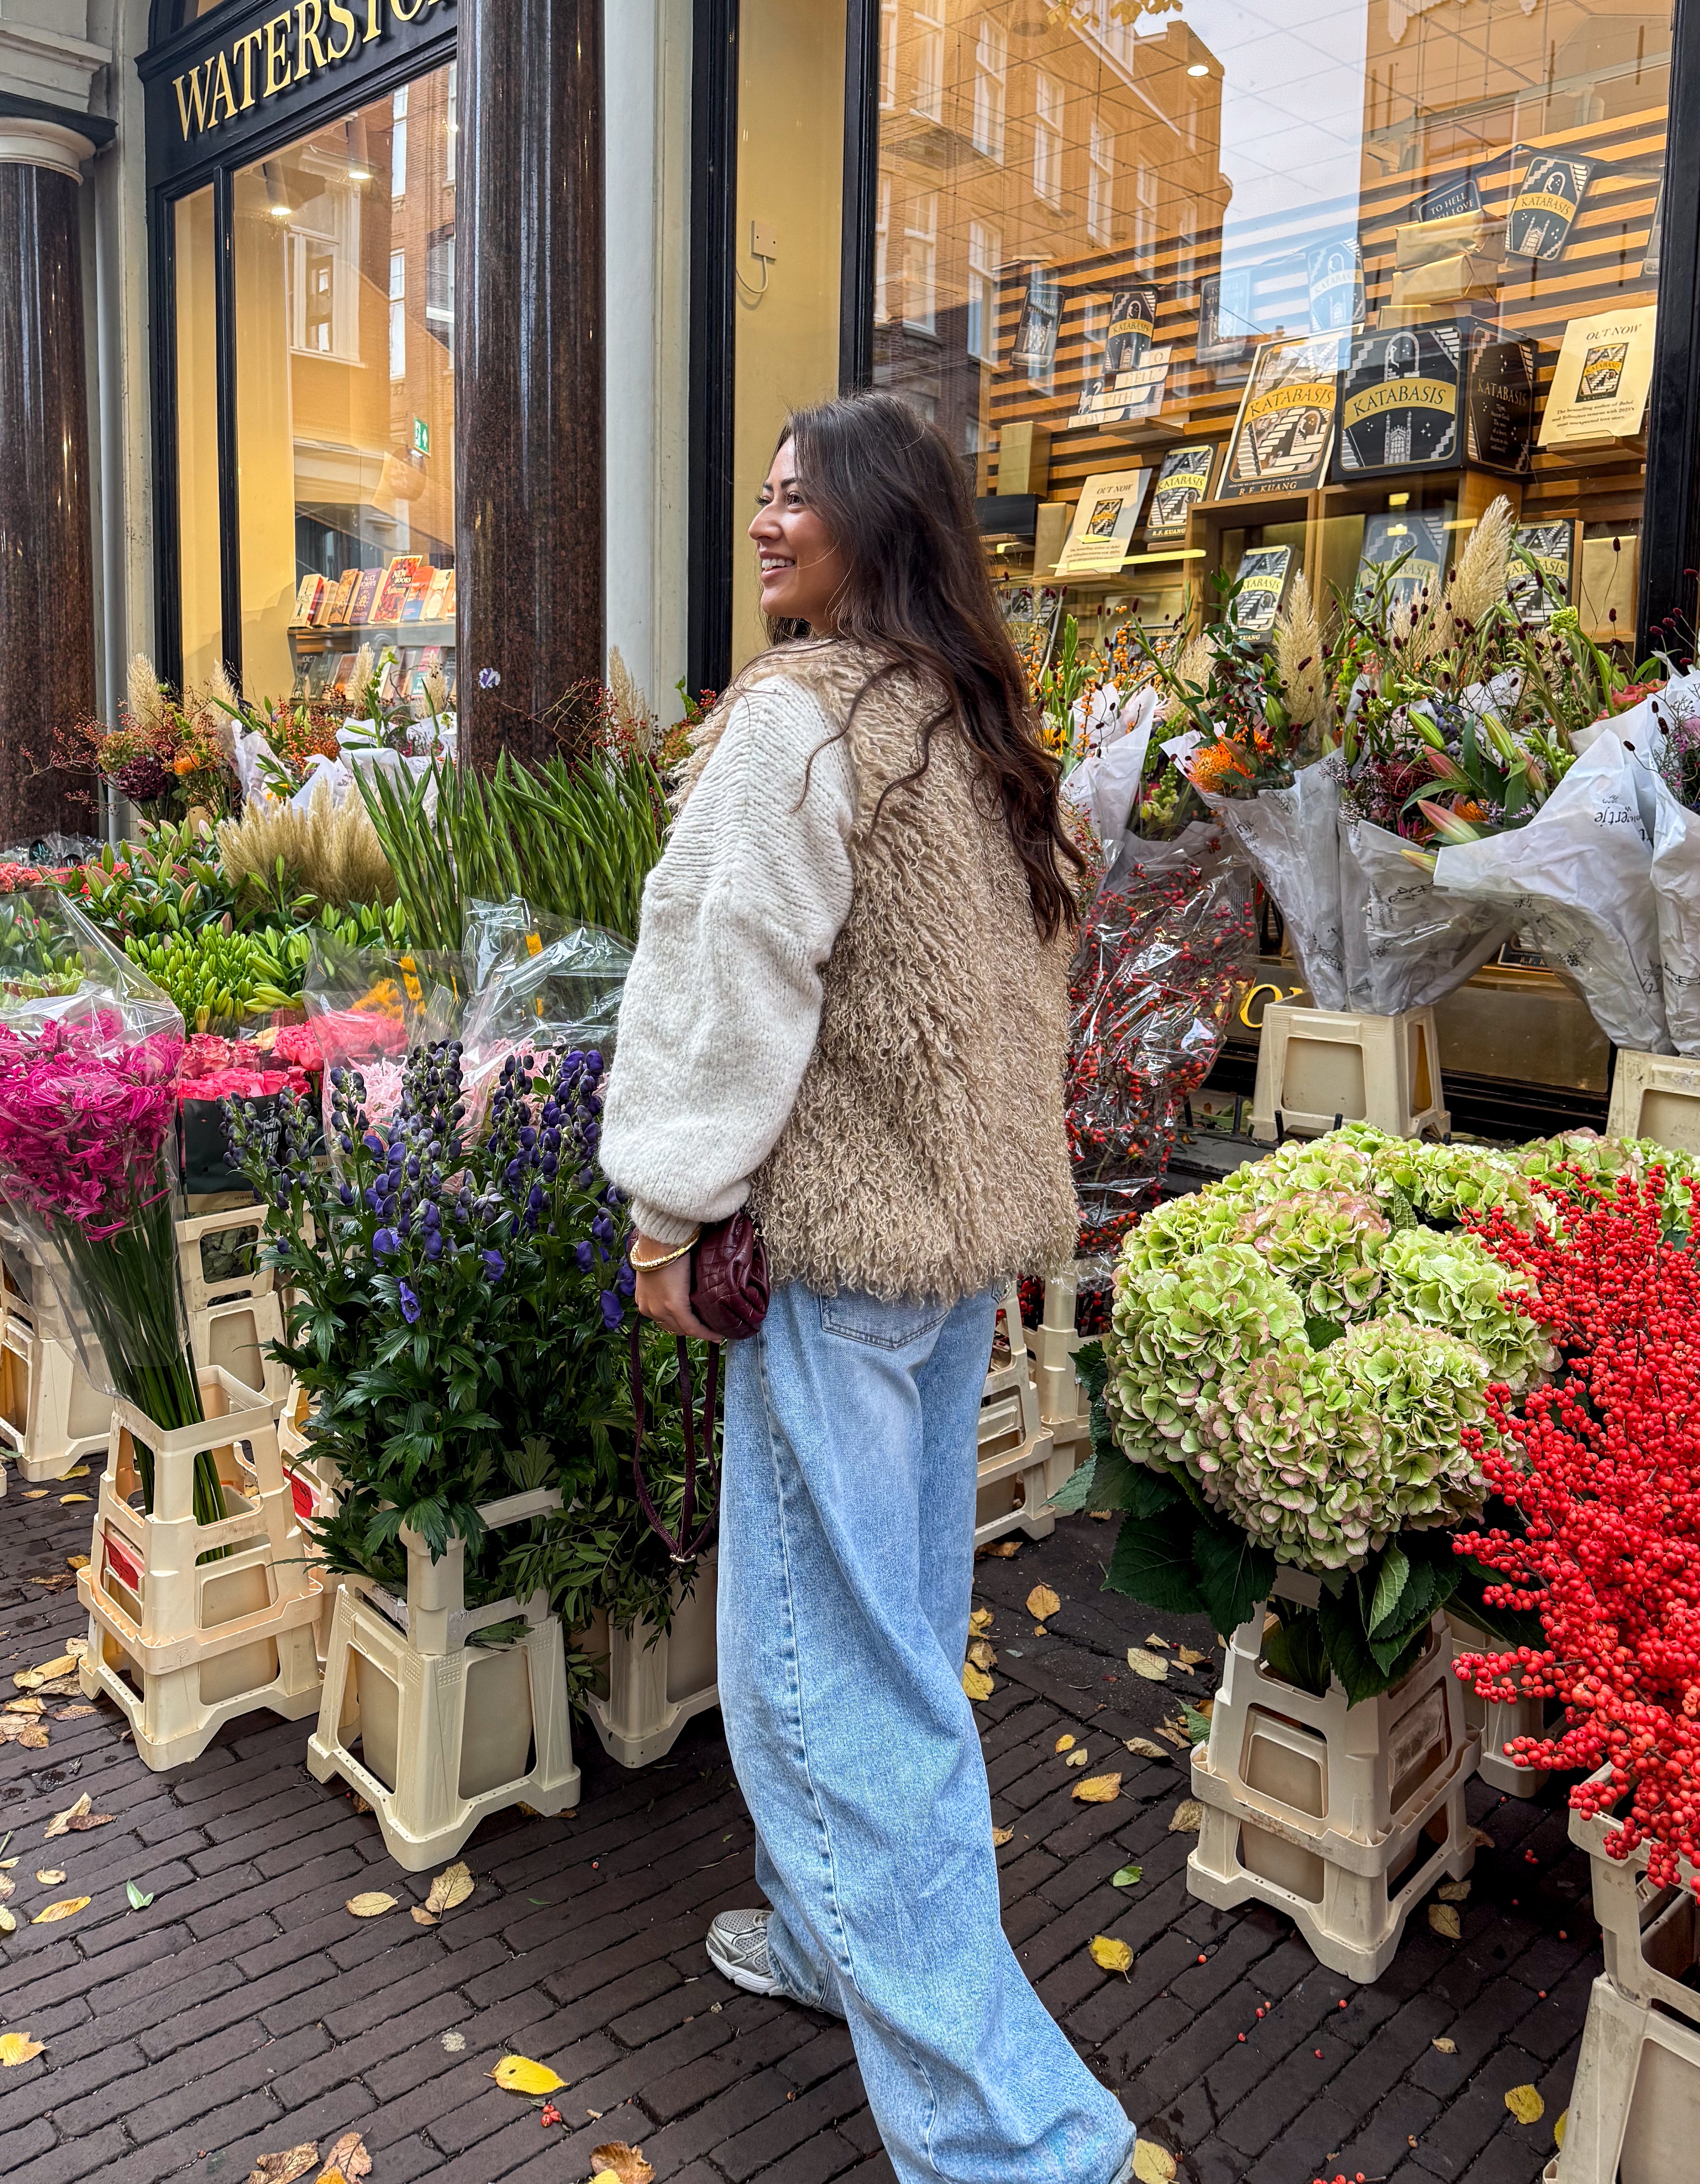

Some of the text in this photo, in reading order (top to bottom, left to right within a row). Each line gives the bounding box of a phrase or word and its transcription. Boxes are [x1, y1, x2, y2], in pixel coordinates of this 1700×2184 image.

[1430, 192, 1467, 215] TO HELL
[1451, 198, 1475, 215] LOVE
[1521, 196, 1571, 216] KATABASIS
[1586, 324, 1642, 341] OUT NOW
[1148, 351, 1163, 365] TO
[1125, 370, 1155, 385] HELL
[1103, 391, 1133, 407] WITH
[1478, 378, 1526, 406] KATABASIS
[1250, 387, 1335, 417] KATABASIS
[1353, 385, 1446, 417] KATABASIS
[1097, 484, 1133, 495] OUT NOW
[1157, 476, 1203, 492] KATABASIS
[1260, 481, 1298, 493] KUANG
[392, 569, 406, 579] NEW
